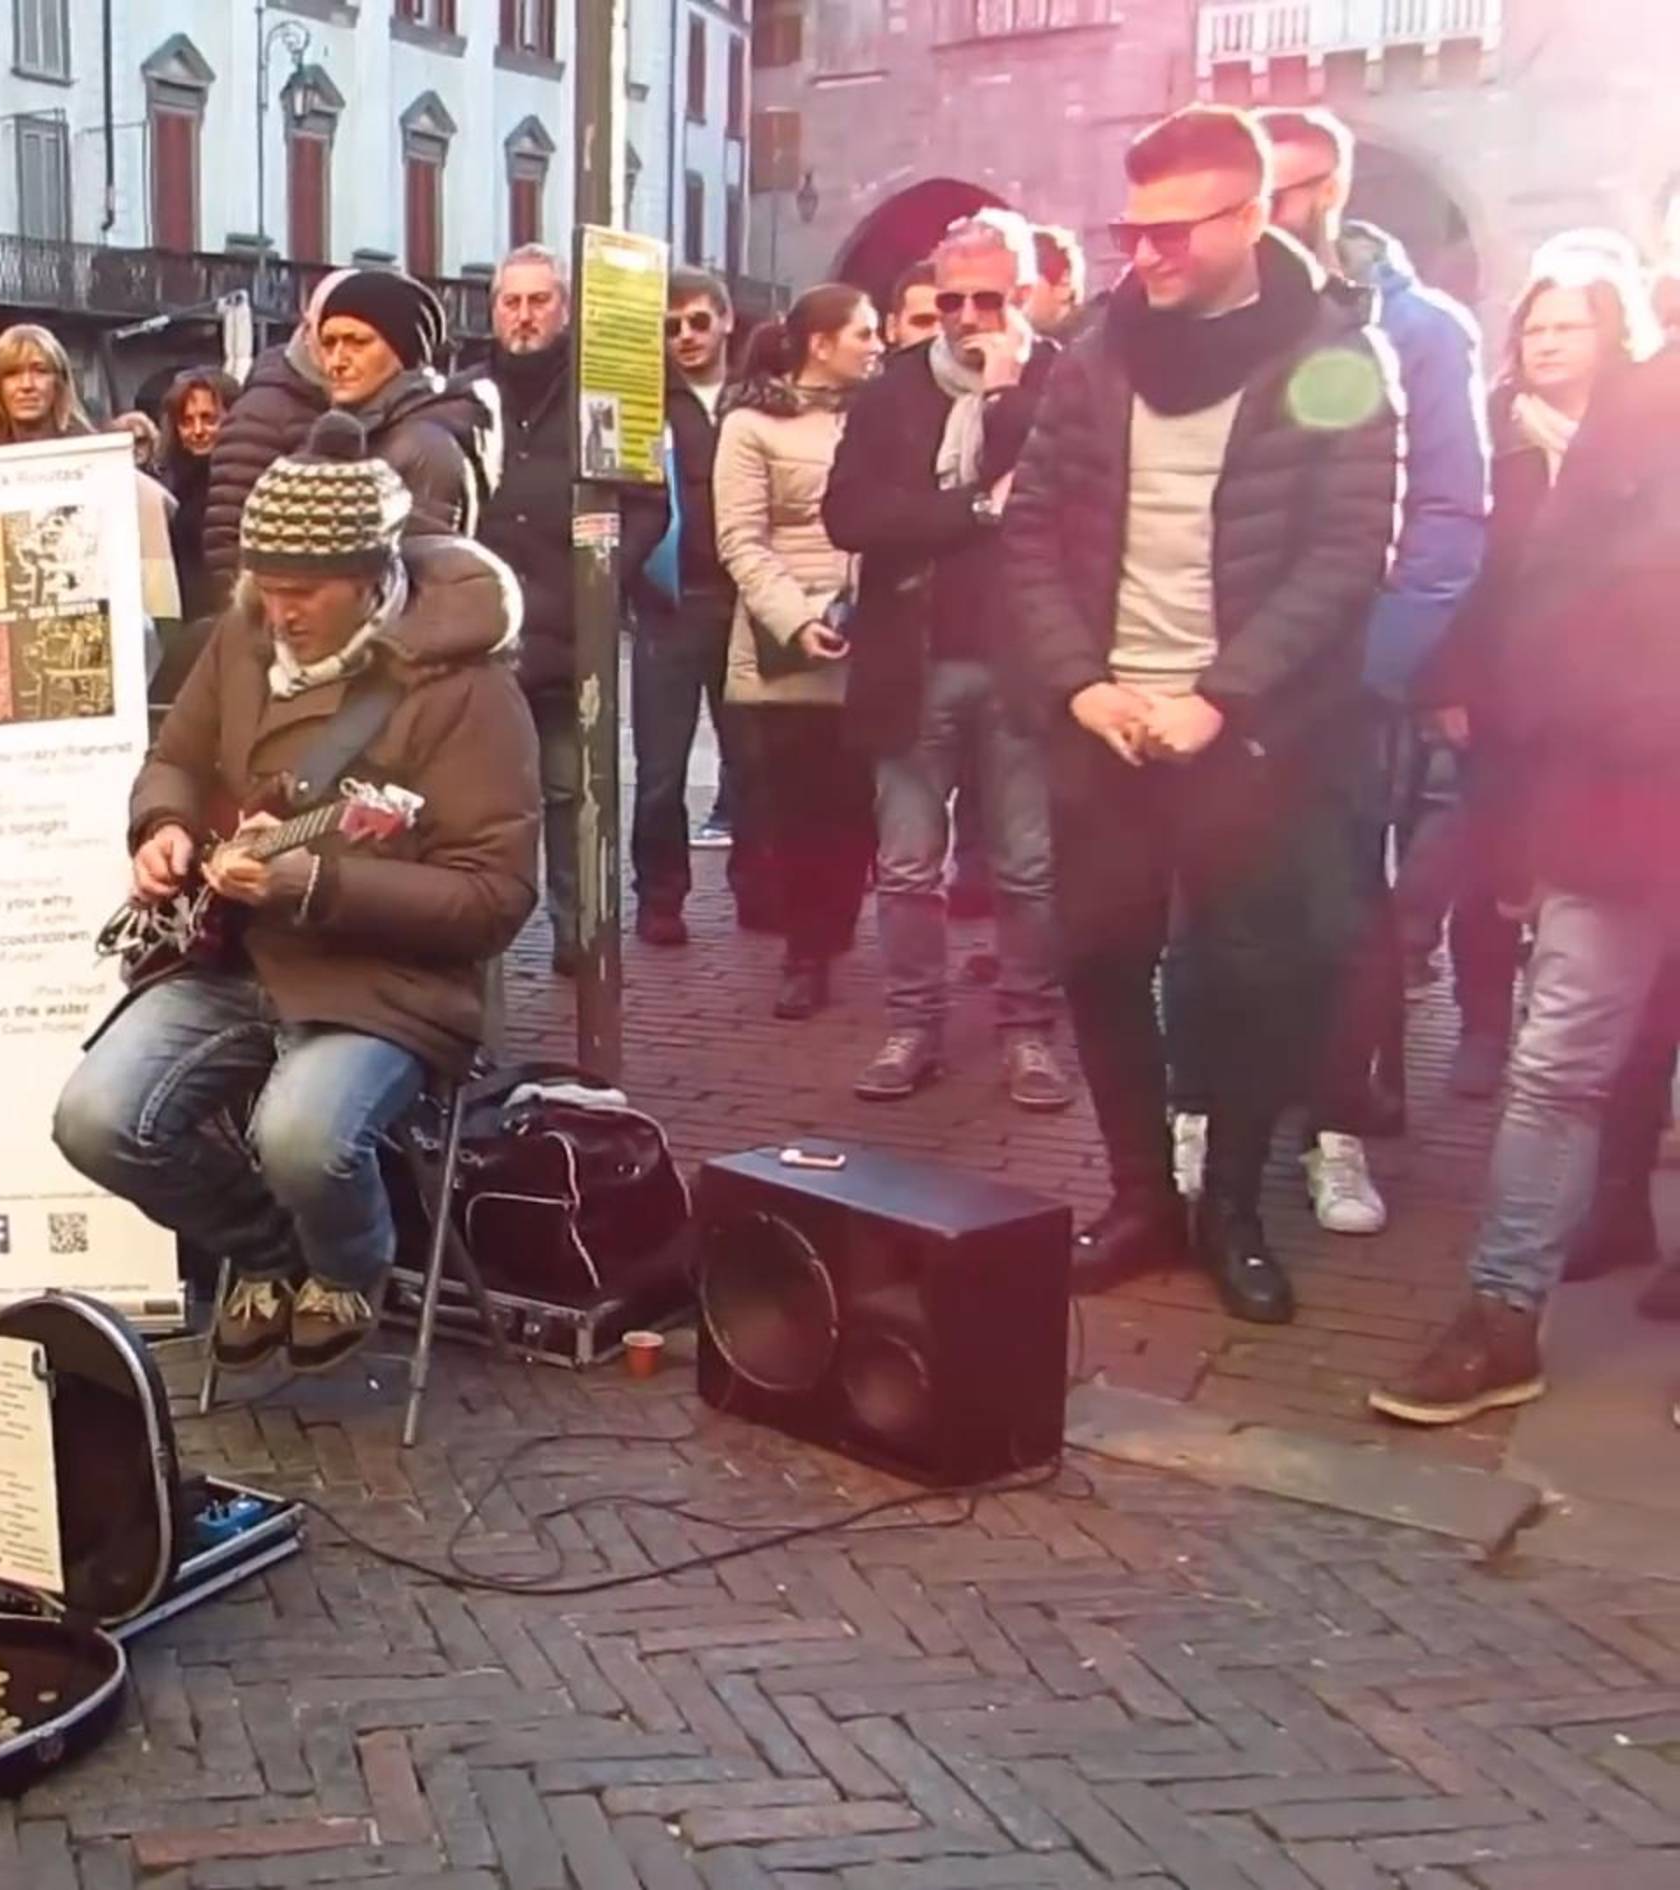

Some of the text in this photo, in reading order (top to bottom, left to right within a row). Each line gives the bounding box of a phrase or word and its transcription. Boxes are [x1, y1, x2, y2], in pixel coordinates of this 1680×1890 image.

[6, 898, 36, 914] you
[15, 1004, 40, 1017] the
[45, 1002, 91, 1017] water
